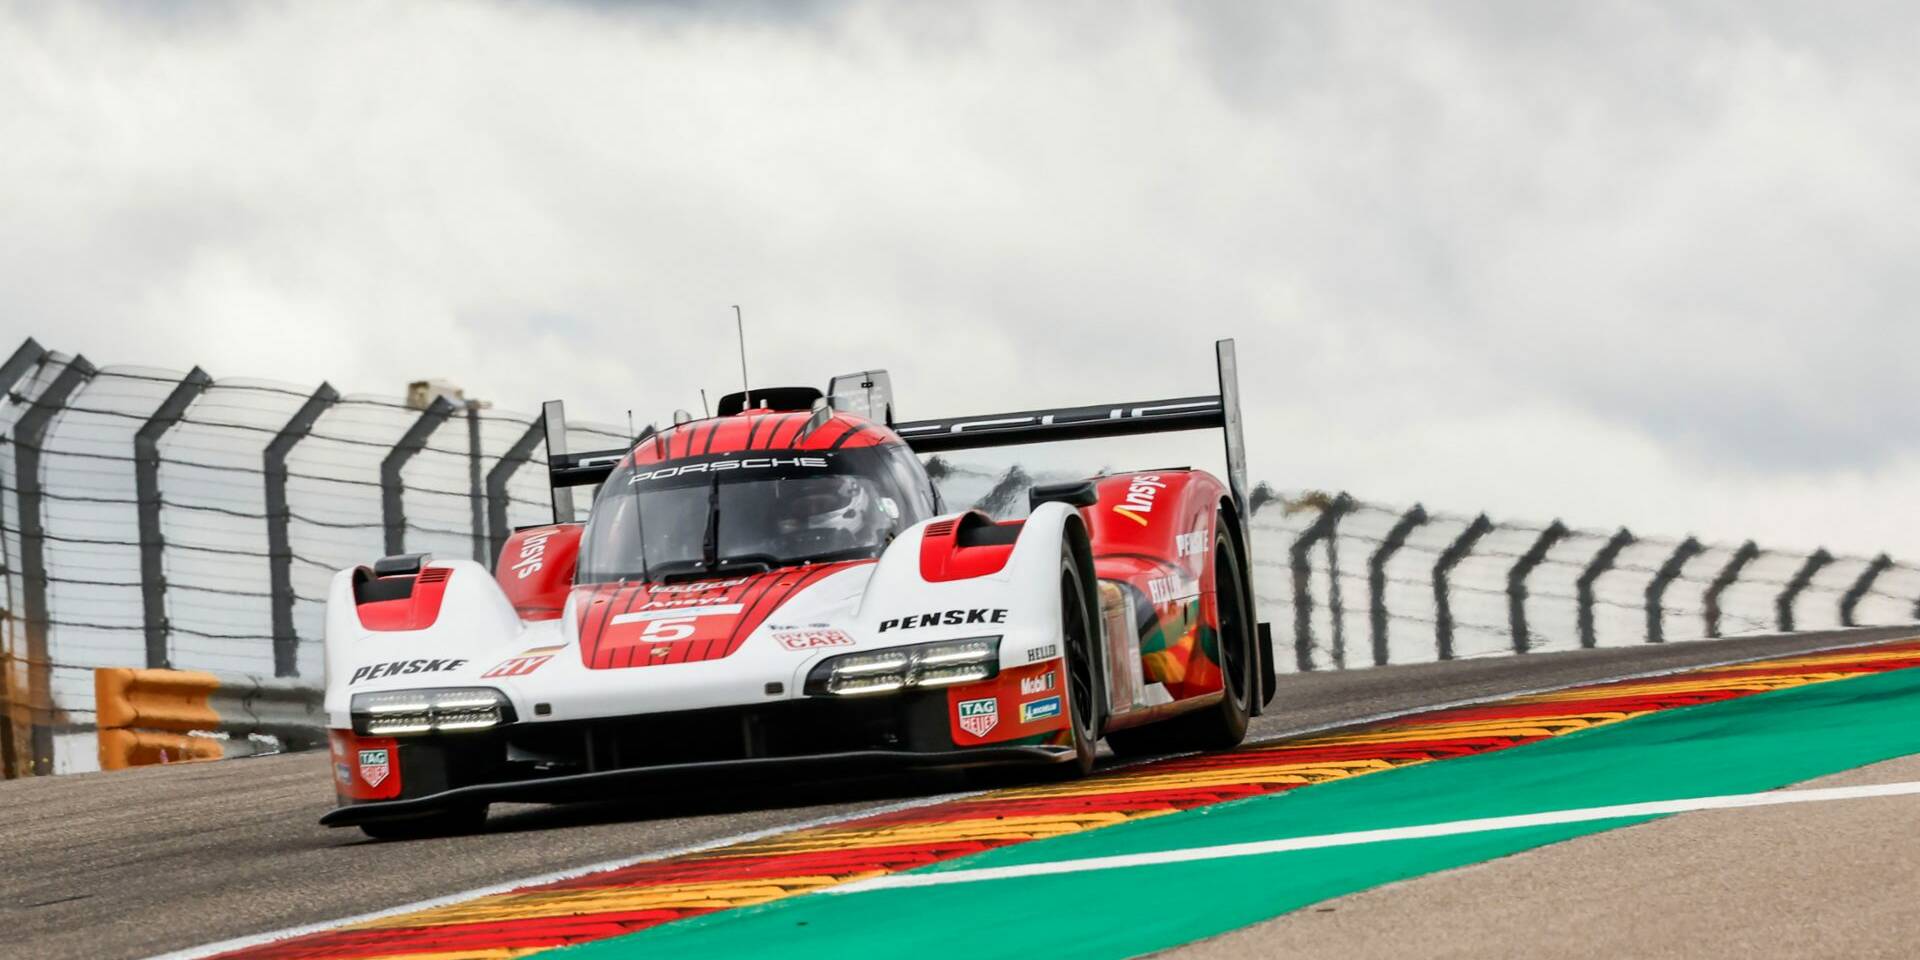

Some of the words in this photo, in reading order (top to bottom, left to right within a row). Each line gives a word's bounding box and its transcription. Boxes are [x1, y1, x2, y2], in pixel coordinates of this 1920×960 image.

[628, 457, 828, 486] PORSCHE
[1112, 475, 1168, 527] Ansys
[511, 529, 560, 580] Ansys
[639, 616, 698, 643] 5
[878, 608, 1009, 633] PENSKE
[786, 634, 849, 648] CAR
[348, 659, 469, 686] PENSKE
[961, 701, 995, 716] TAG
[361, 752, 386, 765] TAG
